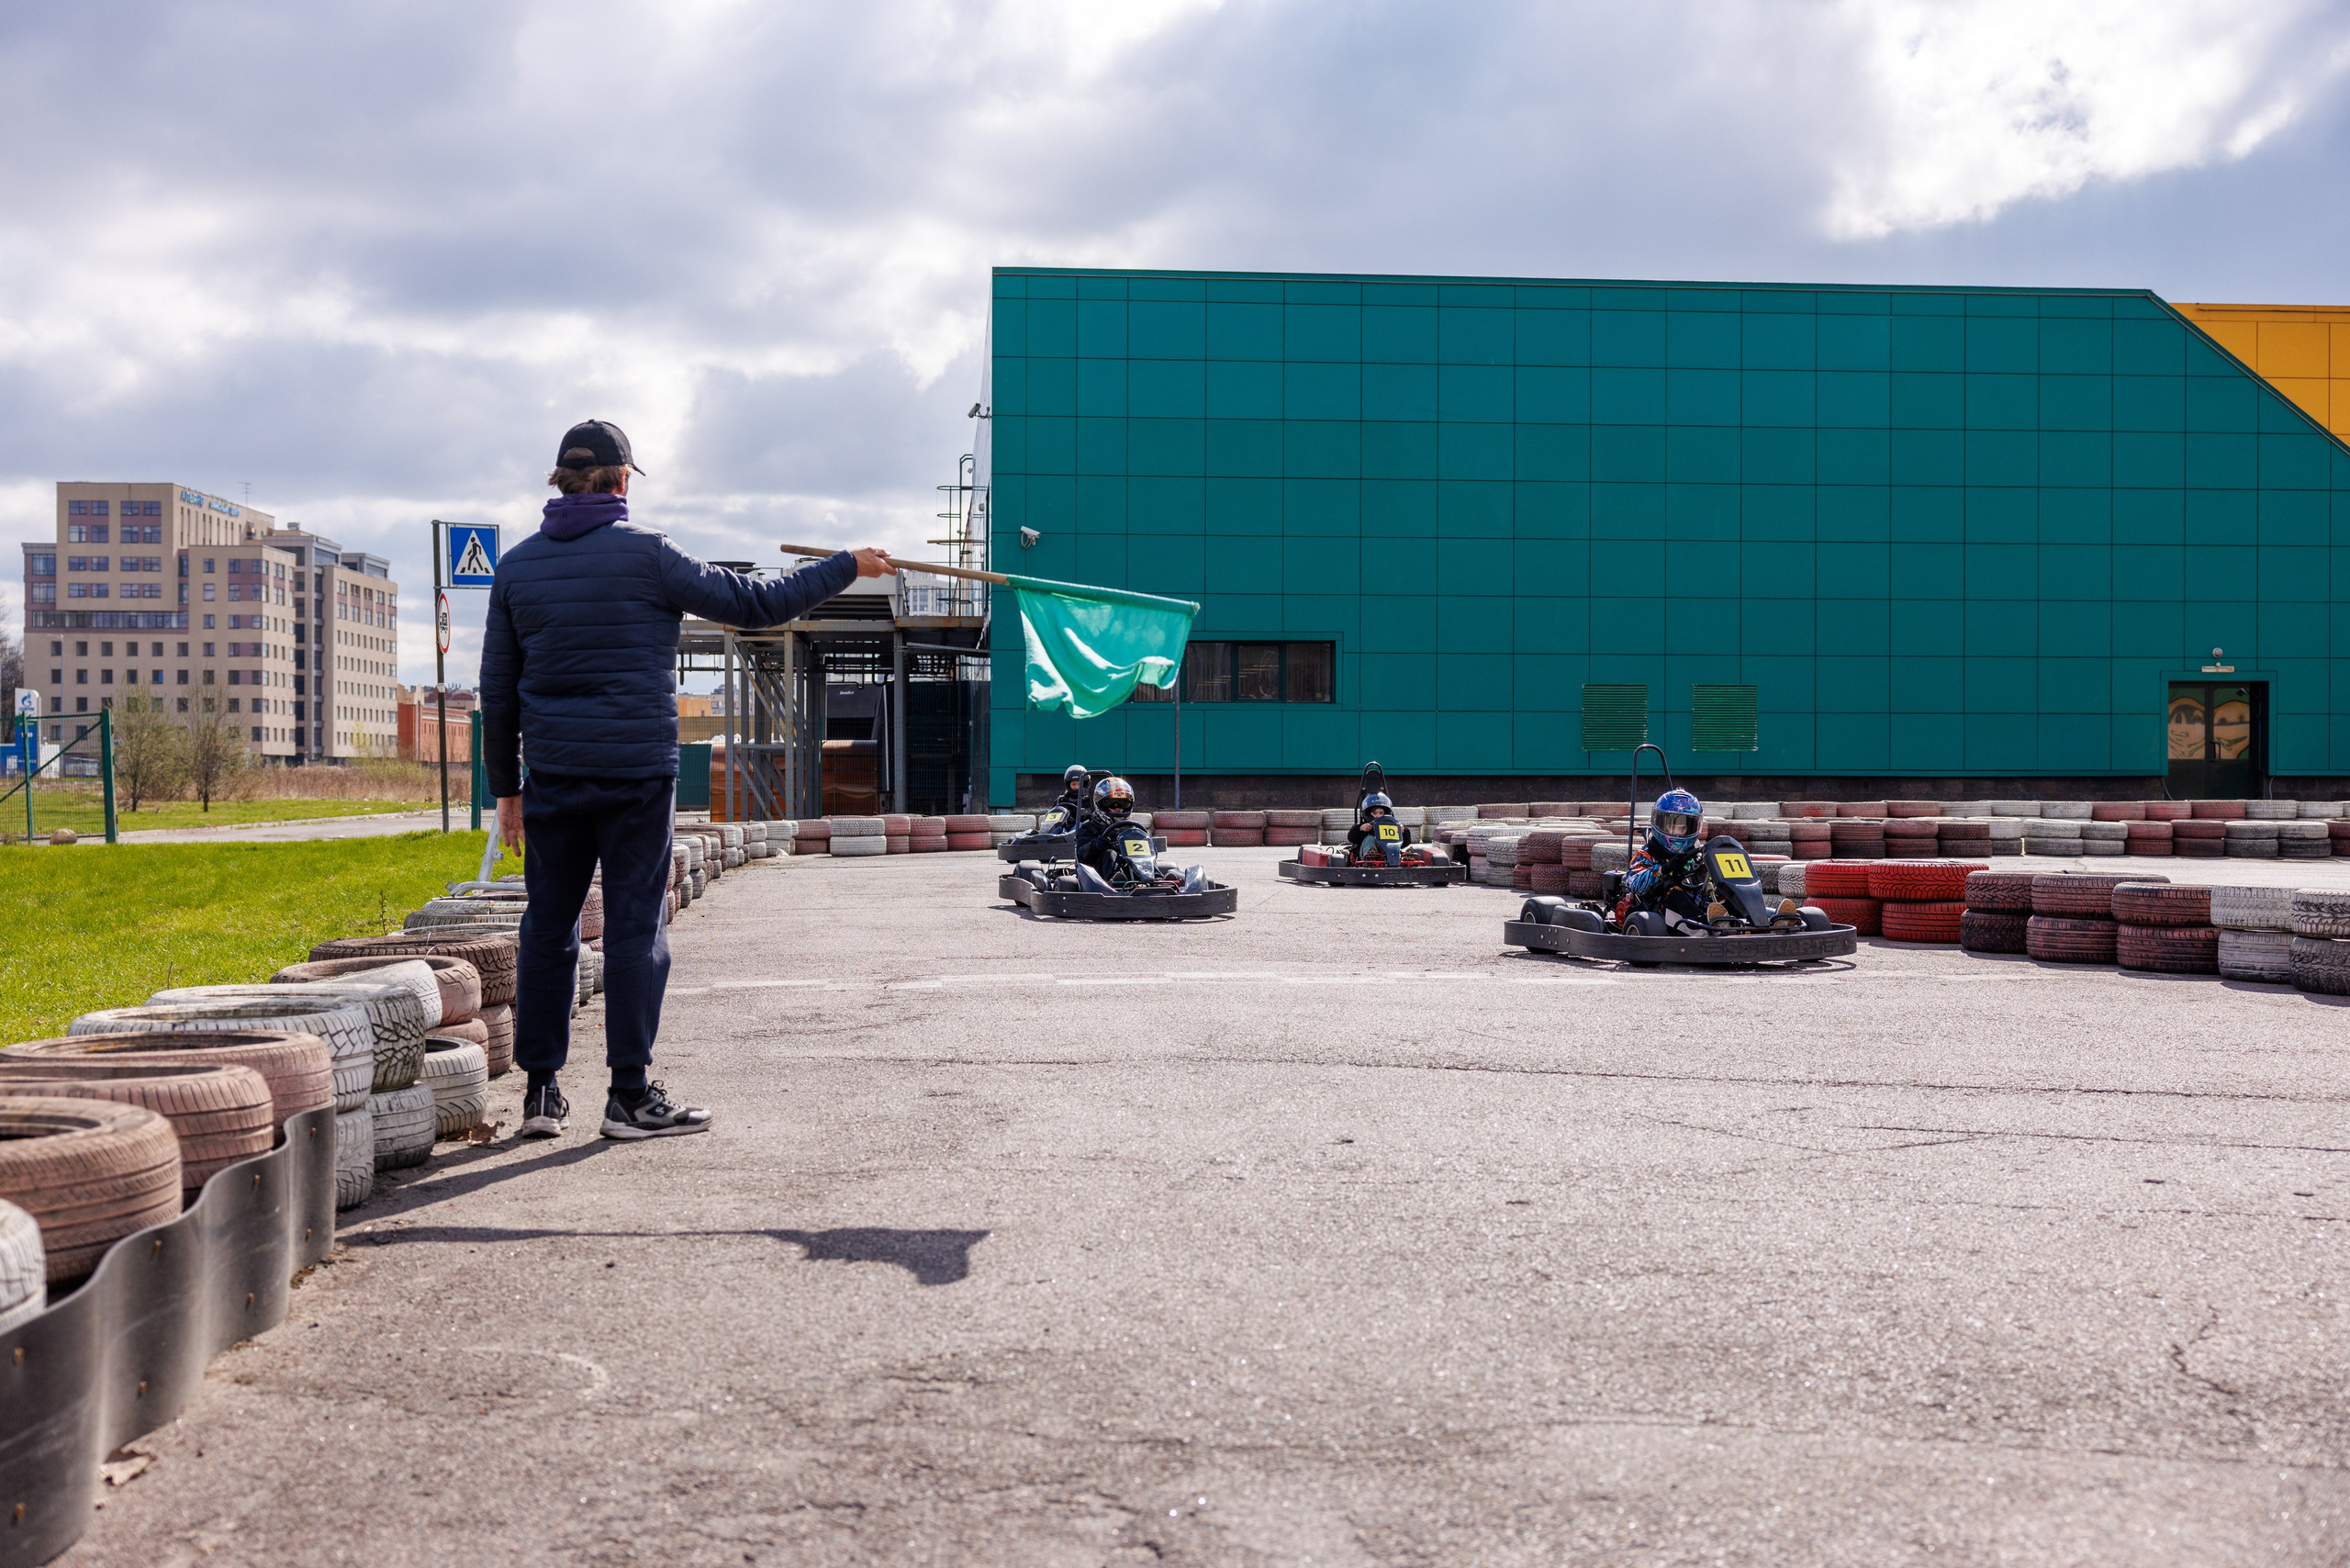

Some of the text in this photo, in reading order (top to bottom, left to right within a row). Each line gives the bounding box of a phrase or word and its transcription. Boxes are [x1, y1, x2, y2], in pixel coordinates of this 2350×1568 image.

[1383, 828, 1395, 837] 10
[1132, 843, 1144, 852] 2
[1725, 859, 1744, 872] 11
